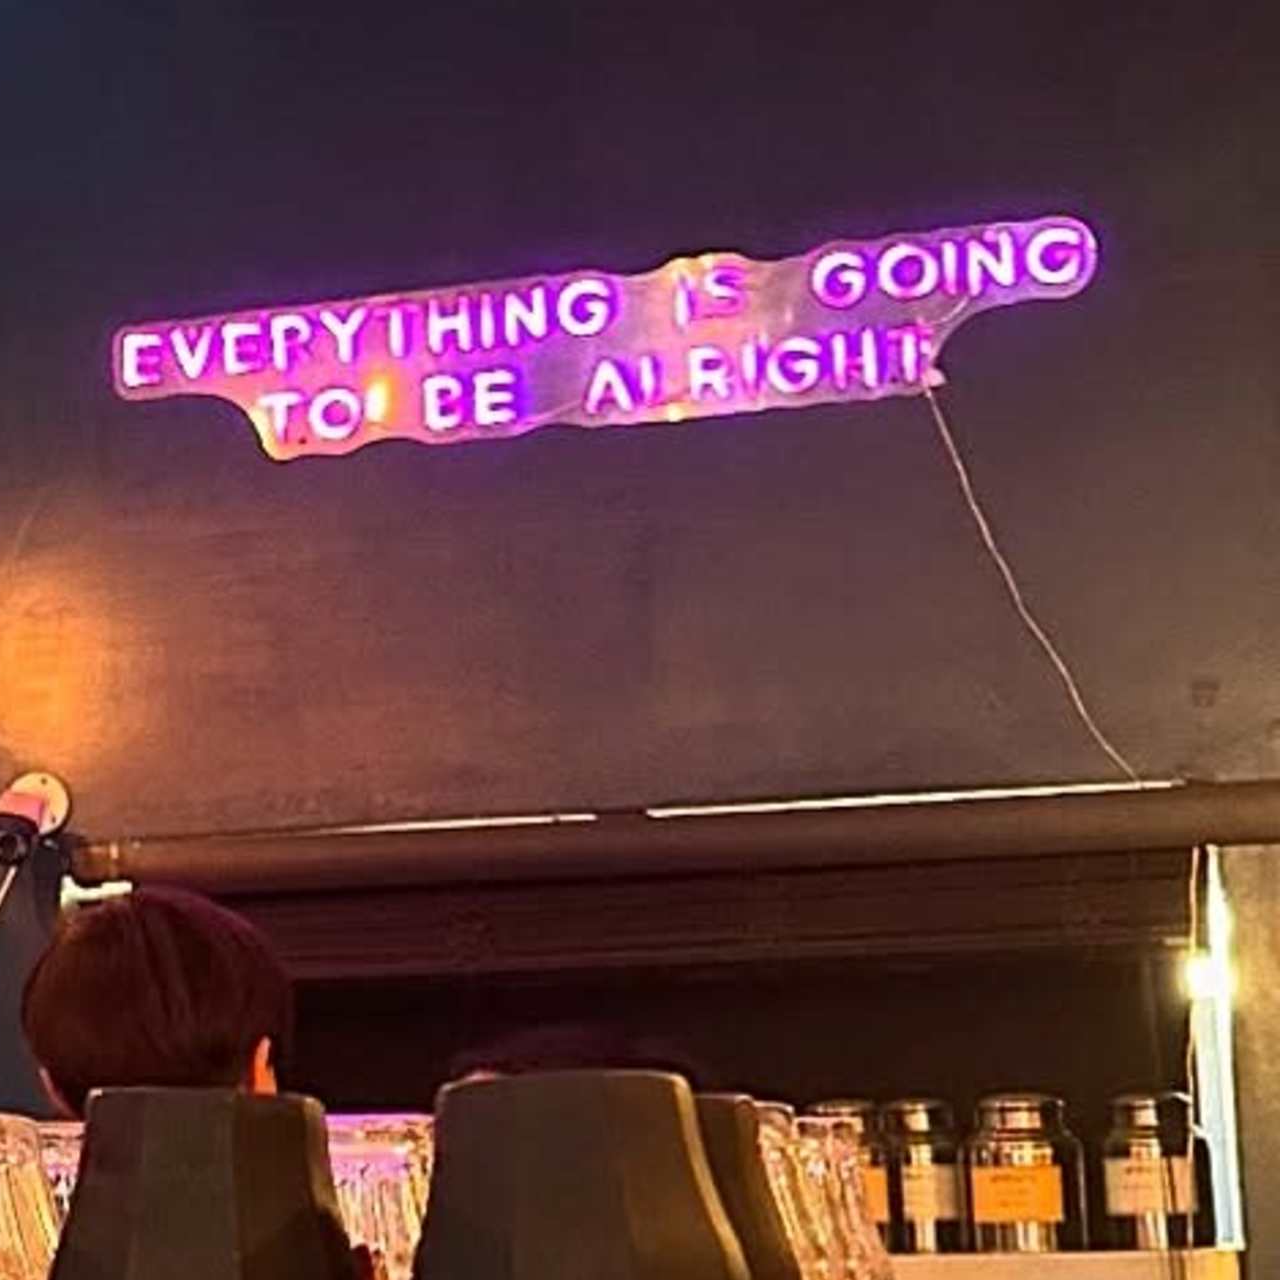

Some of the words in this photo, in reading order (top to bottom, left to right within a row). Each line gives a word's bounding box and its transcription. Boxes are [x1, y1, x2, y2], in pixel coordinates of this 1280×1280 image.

[122, 278, 614, 388] EVERYTHING
[675, 266, 747, 329] IS
[811, 227, 1082, 309] GOING
[259, 388, 361, 443] TO
[423, 368, 516, 431] BE
[586, 322, 930, 416] ALRIGHT
